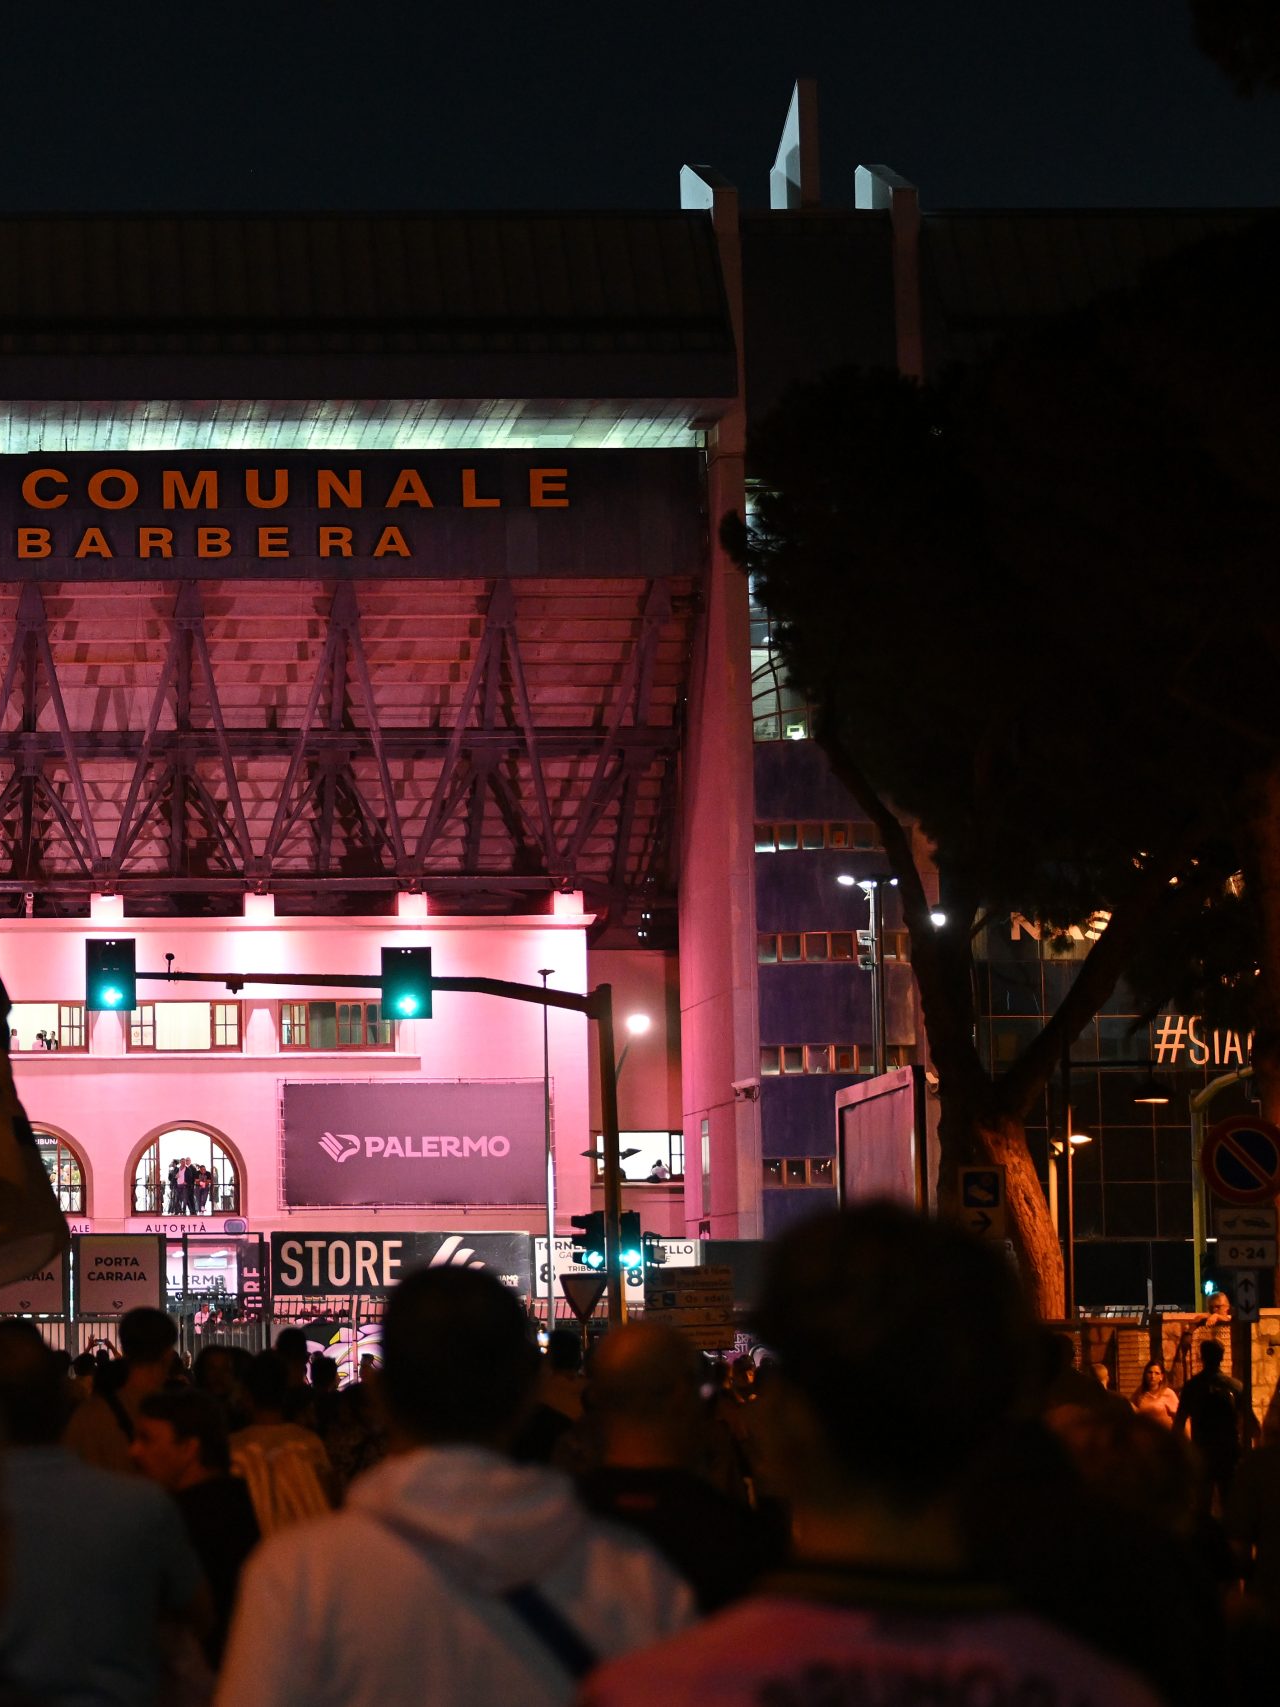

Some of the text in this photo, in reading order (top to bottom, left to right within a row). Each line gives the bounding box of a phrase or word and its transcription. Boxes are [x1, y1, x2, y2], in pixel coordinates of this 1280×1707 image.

[22, 468, 570, 510] COMUNALE
[17, 526, 412, 558] BARBERA
[364, 1135, 510, 1158] PALERMO
[145, 1222, 207, 1233] AUTORITÀ
[94, 1256, 140, 1267] PORTA
[279, 1239, 404, 1288] STORE
[1228, 1247, 1266, 1259] 0-24
[87, 1271, 147, 1281] CARRAIA
[539, 1262, 556, 1284] 8
[626, 1266, 644, 1287] 8
